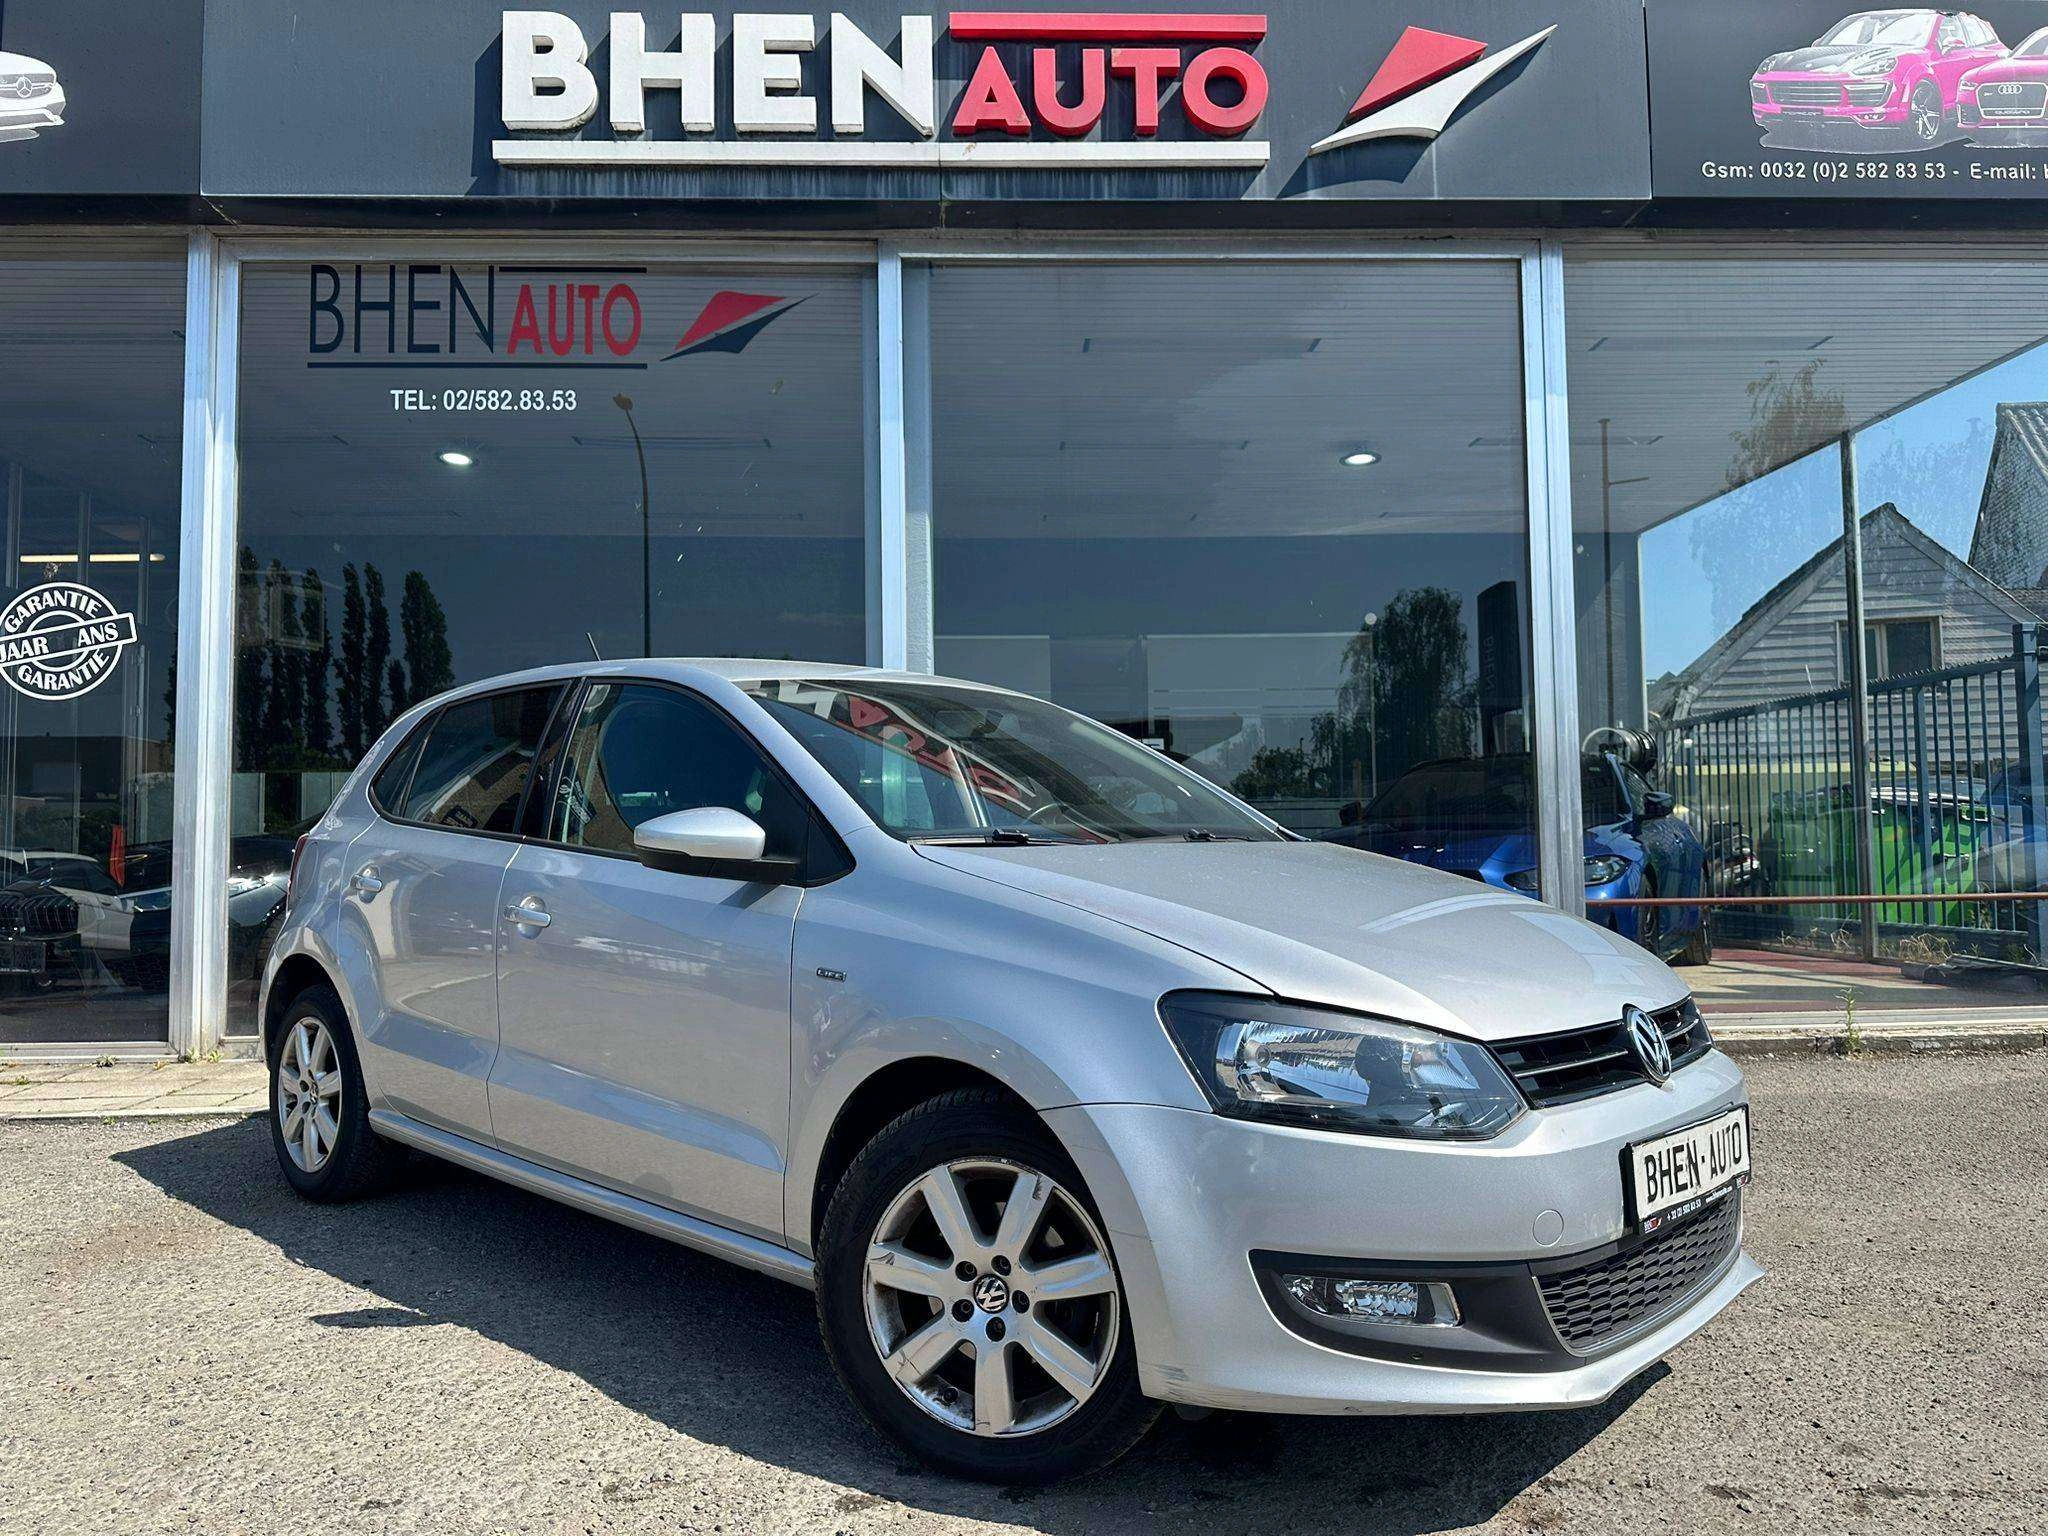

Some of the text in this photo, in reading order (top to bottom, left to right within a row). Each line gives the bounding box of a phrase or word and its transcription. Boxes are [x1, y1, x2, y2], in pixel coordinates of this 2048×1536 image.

[501, 10, 1269, 137] BHEN AUTO
[1701, 161, 1754, 178] Gsm:
[1760, 162, 1806, 178] 0032
[1813, 161, 1849, 182] (0)2
[1855, 162, 1889, 179] 582
[1895, 162, 1918, 179] 83
[1924, 162, 1946, 179] 53
[1970, 162, 2037, 180] E-mail:
[309, 264, 643, 357] BHEN AUTO
[390, 388, 578, 413] TEL: 02/582.83.53
[4, 590, 102, 633] GARANTIE
[0, 621, 119, 662] JAAR ANS
[17, 648, 110, 691] GARANTIE
[1645, 1140, 1701, 1203] BHEN
[1711, 1122, 1742, 1179] AUTO
